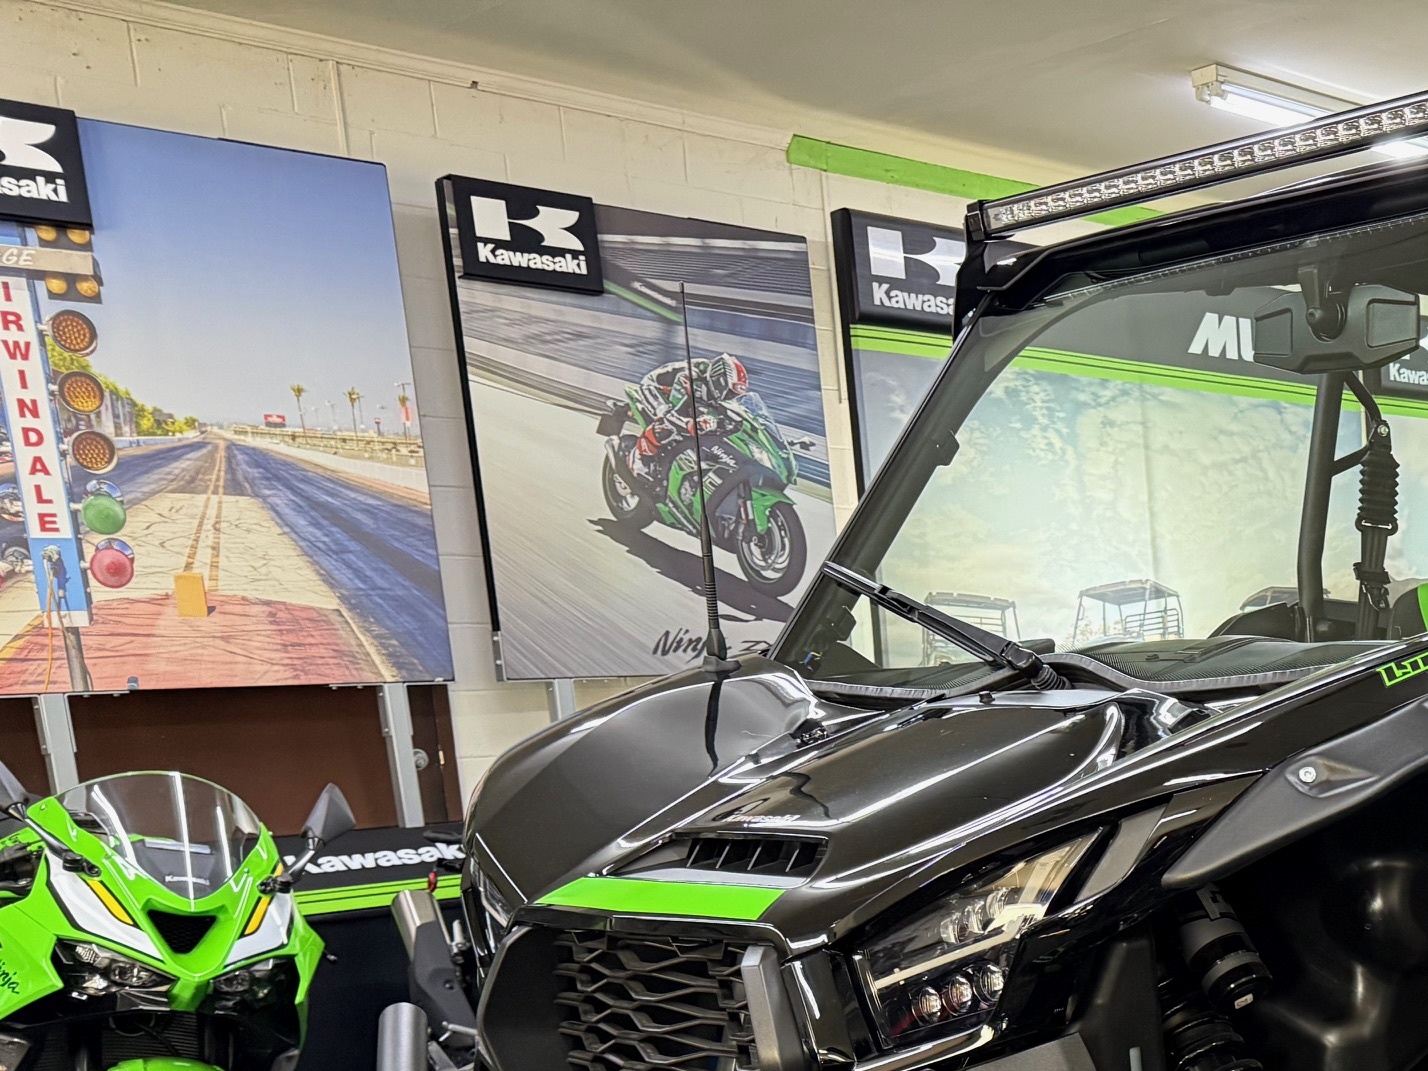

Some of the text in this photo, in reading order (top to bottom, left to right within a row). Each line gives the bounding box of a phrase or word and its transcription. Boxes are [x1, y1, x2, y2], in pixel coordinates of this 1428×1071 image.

[0, 175, 69, 203] saki
[0, 246, 36, 265] GE
[476, 241, 588, 275] Kawasaki
[0, 281, 61, 534] IRWINDALE
[652, 627, 733, 664] Ninj
[283, 842, 467, 875] awasak
